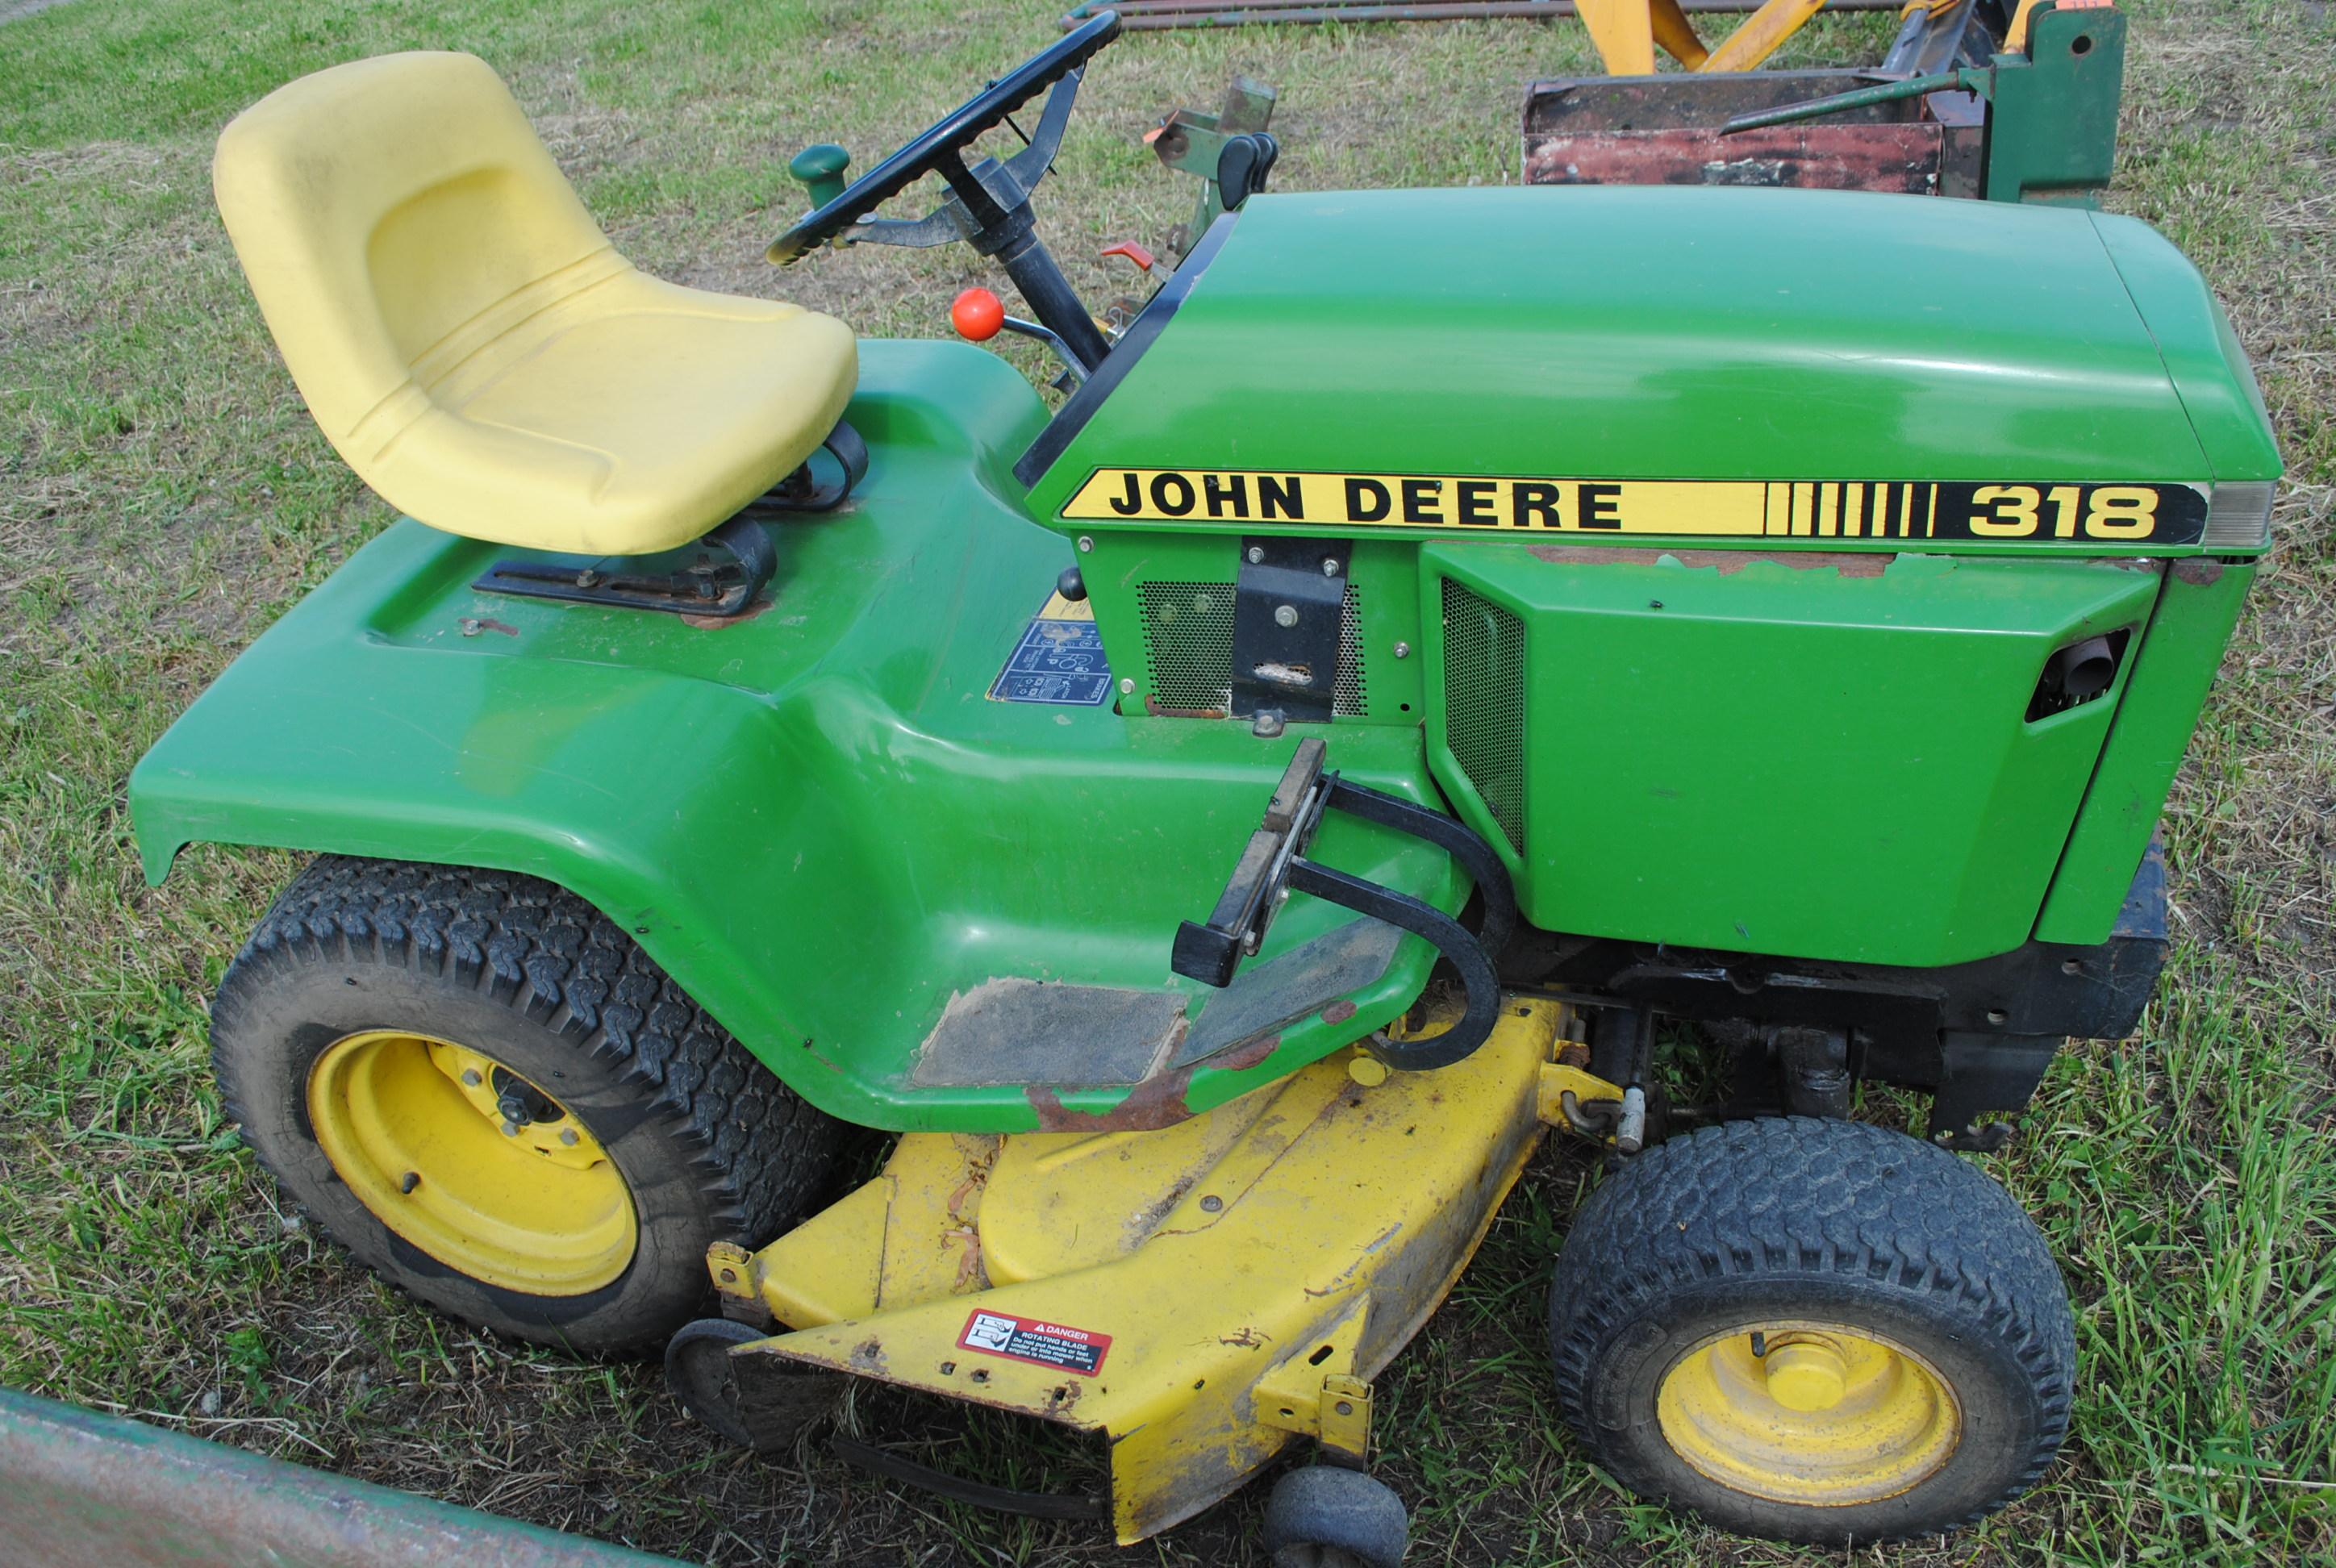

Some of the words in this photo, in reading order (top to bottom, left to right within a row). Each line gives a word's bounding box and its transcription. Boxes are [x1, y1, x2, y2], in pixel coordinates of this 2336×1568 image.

[1109, 470, 1304, 520] JOHN
[1345, 477, 1622, 530] DEERE
[1968, 486, 2159, 540] 318
[1091, 678, 1105, 699] BRAKES
[1021, 1332, 1061, 1345] ROTATING
[1062, 1340, 1088, 1350] BLADE
[1046, 1325, 1089, 1341] DANGER
[1008, 1347, 1031, 1356] engine
[1038, 1353, 1064, 1364] running
[1039, 1347, 1052, 1355] into
[1053, 1351, 1075, 1360] mower
[1075, 1355, 1093, 1364] when
[1047, 1344, 1067, 1353] hands
